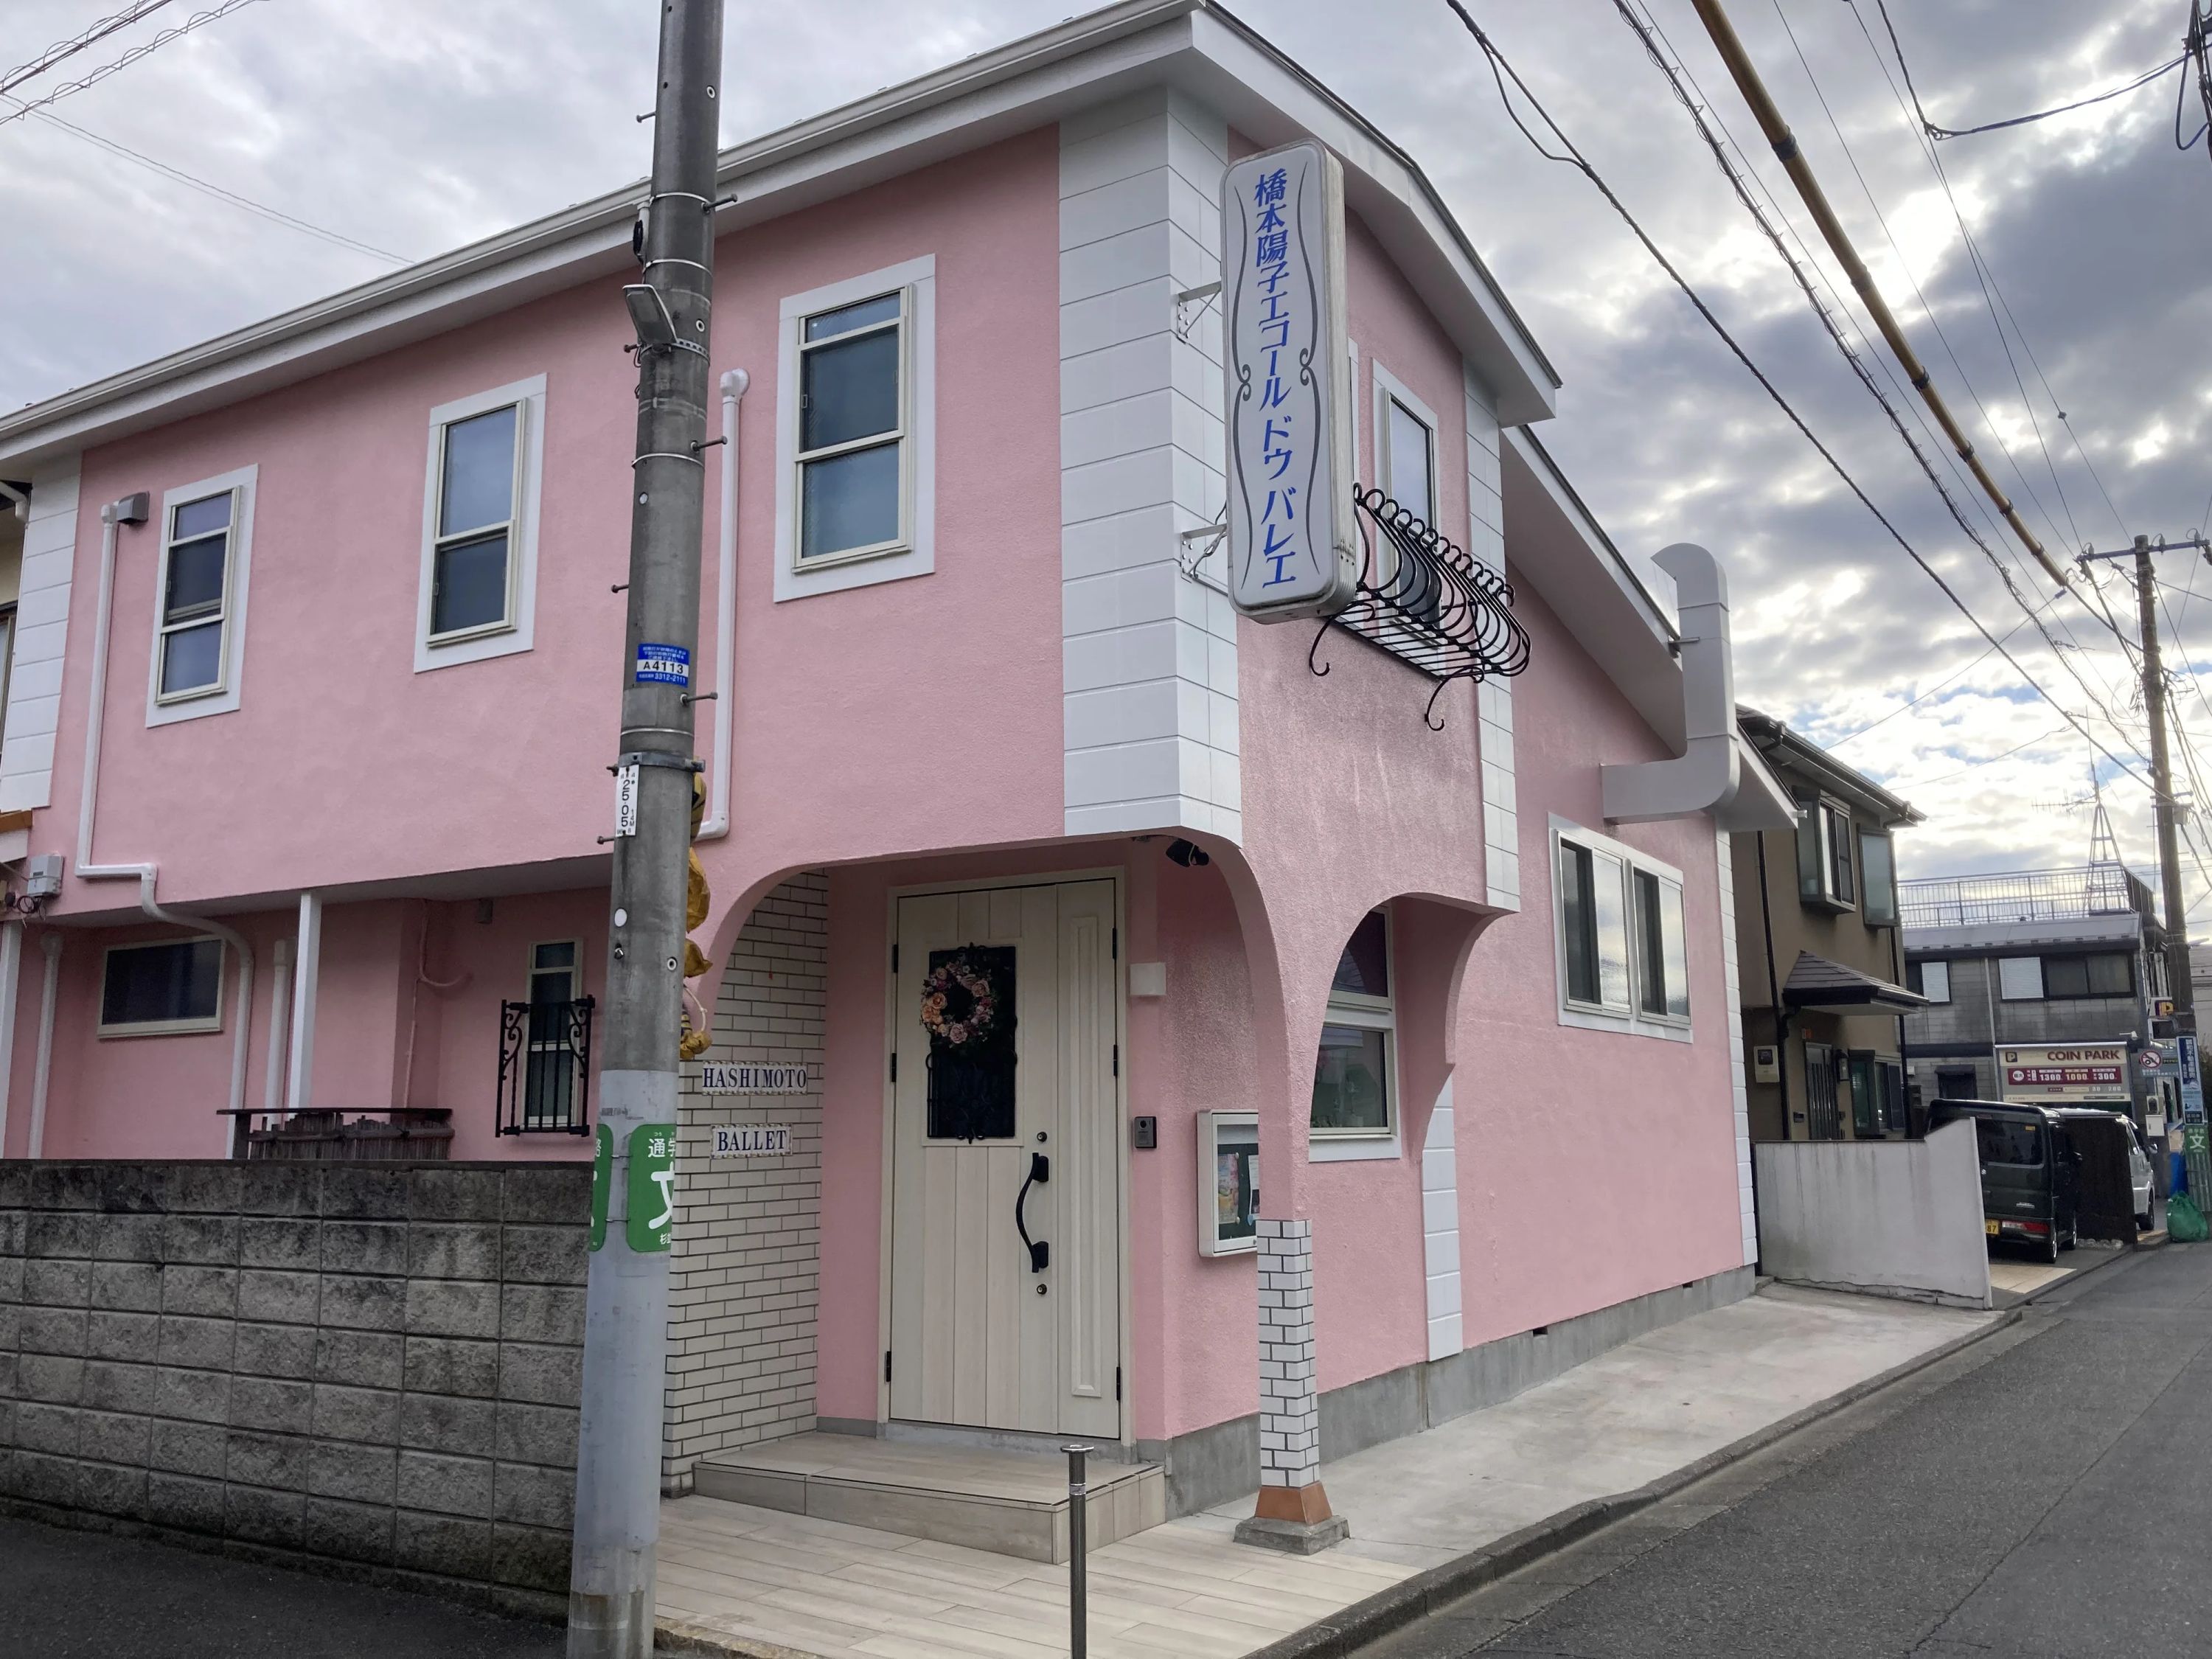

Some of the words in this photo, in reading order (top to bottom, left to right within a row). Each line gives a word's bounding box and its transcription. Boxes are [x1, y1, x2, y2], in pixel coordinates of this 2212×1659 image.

[643, 661, 684, 674] A4113
[2047, 1051, 2081, 1061] COIN
[2084, 1050, 2120, 1060] PARK
[702, 1068, 807, 1088] HASHIMOTO
[717, 1130, 786, 1151] BALLET
[2189, 1134, 2205, 1149] 文
